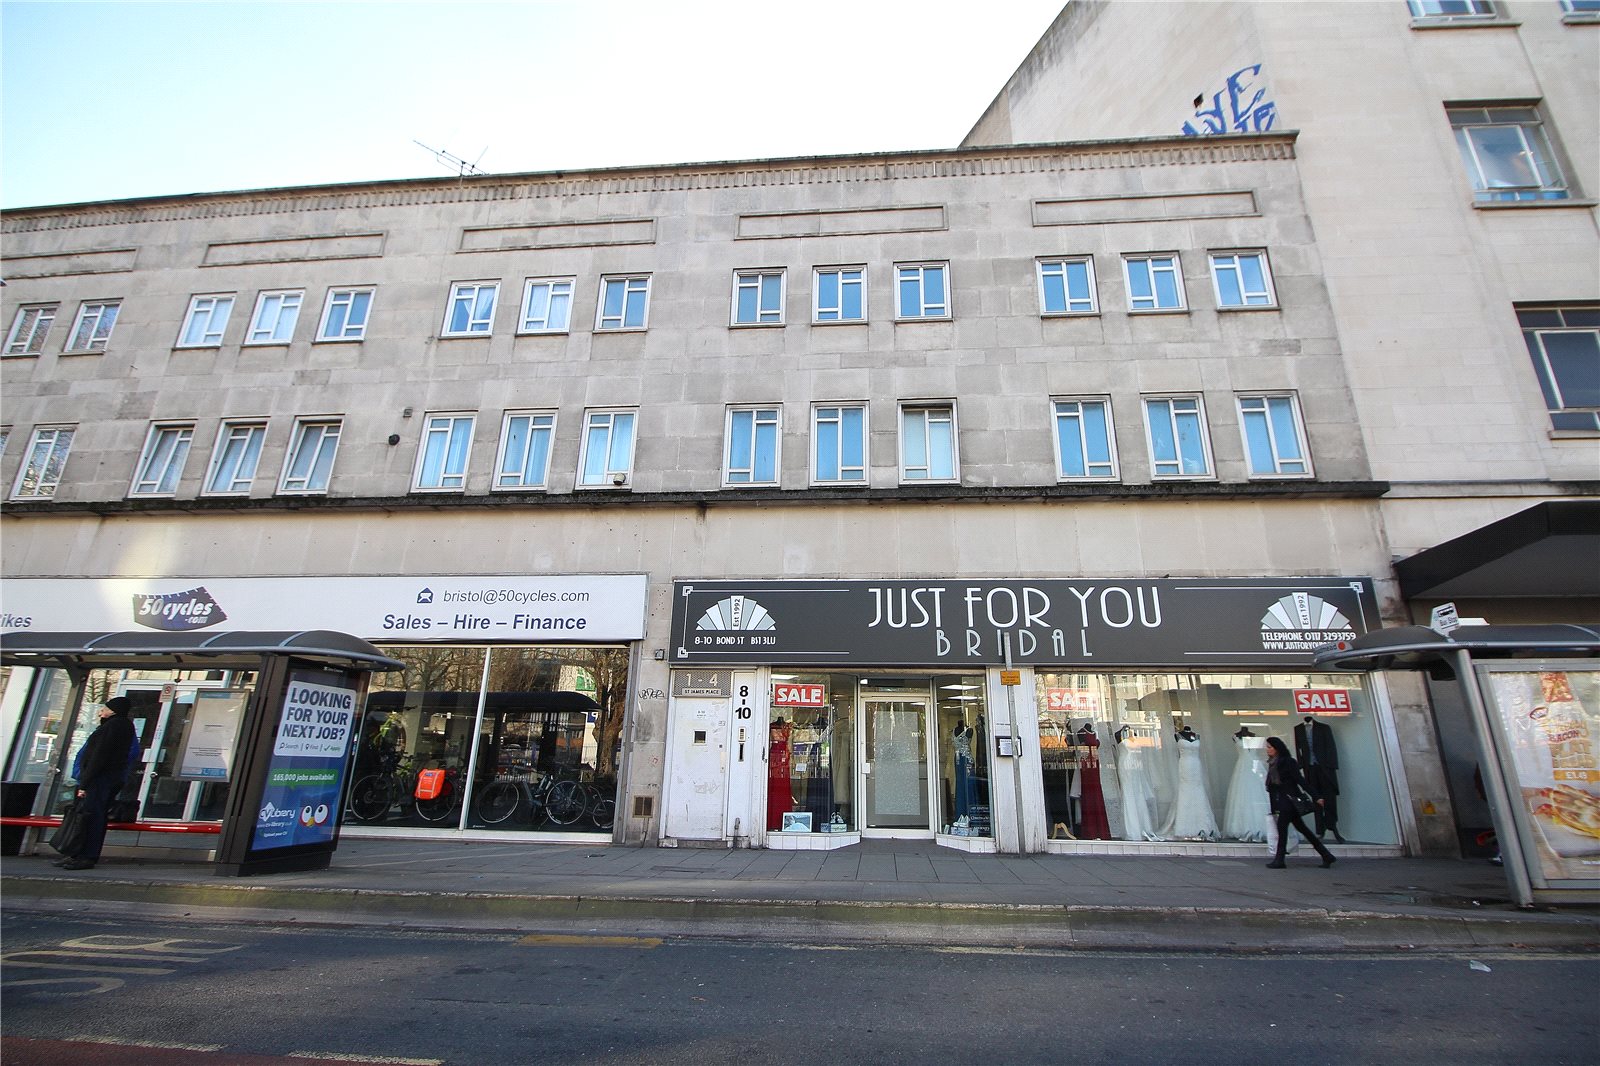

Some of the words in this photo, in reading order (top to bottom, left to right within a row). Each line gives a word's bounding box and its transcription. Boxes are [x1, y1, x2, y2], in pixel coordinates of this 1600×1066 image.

[443, 589, 590, 605] bristol@50cycles.com
[1297, 595, 1306, 612] 1992
[138, 598, 214, 620] 50cycles
[868, 587, 946, 628] JUST
[964, 587, 1051, 628] FOR
[1068, 586, 1162, 628] YOU
[382, 614, 432, 630] Sales
[453, 614, 491, 630] Hire
[513, 614, 587, 630] Finance
[694, 636, 713, 645] 8-10
[716, 636, 736, 645] BOND
[736, 636, 745, 645] ST
[763, 636, 776, 645] 3LU
[936, 629, 1093, 657] BRIDAL
[1261, 632, 1303, 641] TELEPHONE
[1304, 632, 1321, 641] 0117
[1322, 632, 1356, 641] 3293759
[686, 673, 692, 686] 1
[709, 673, 718, 686] 4
[290, 687, 351, 709] LOOKING
[739, 686, 748, 697] 8
[777, 688, 822, 703] SALE
[1298, 691, 1348, 709] SALE
[287, 707, 312, 722] FOR
[316, 709, 348, 725] YOUR
[735, 707, 751, 719] 10
[282, 724, 315, 739] NEXT
[316, 726, 345, 740] JOB?
[273, 773, 296, 781] 165,000
[296, 774, 308, 782] jobs
